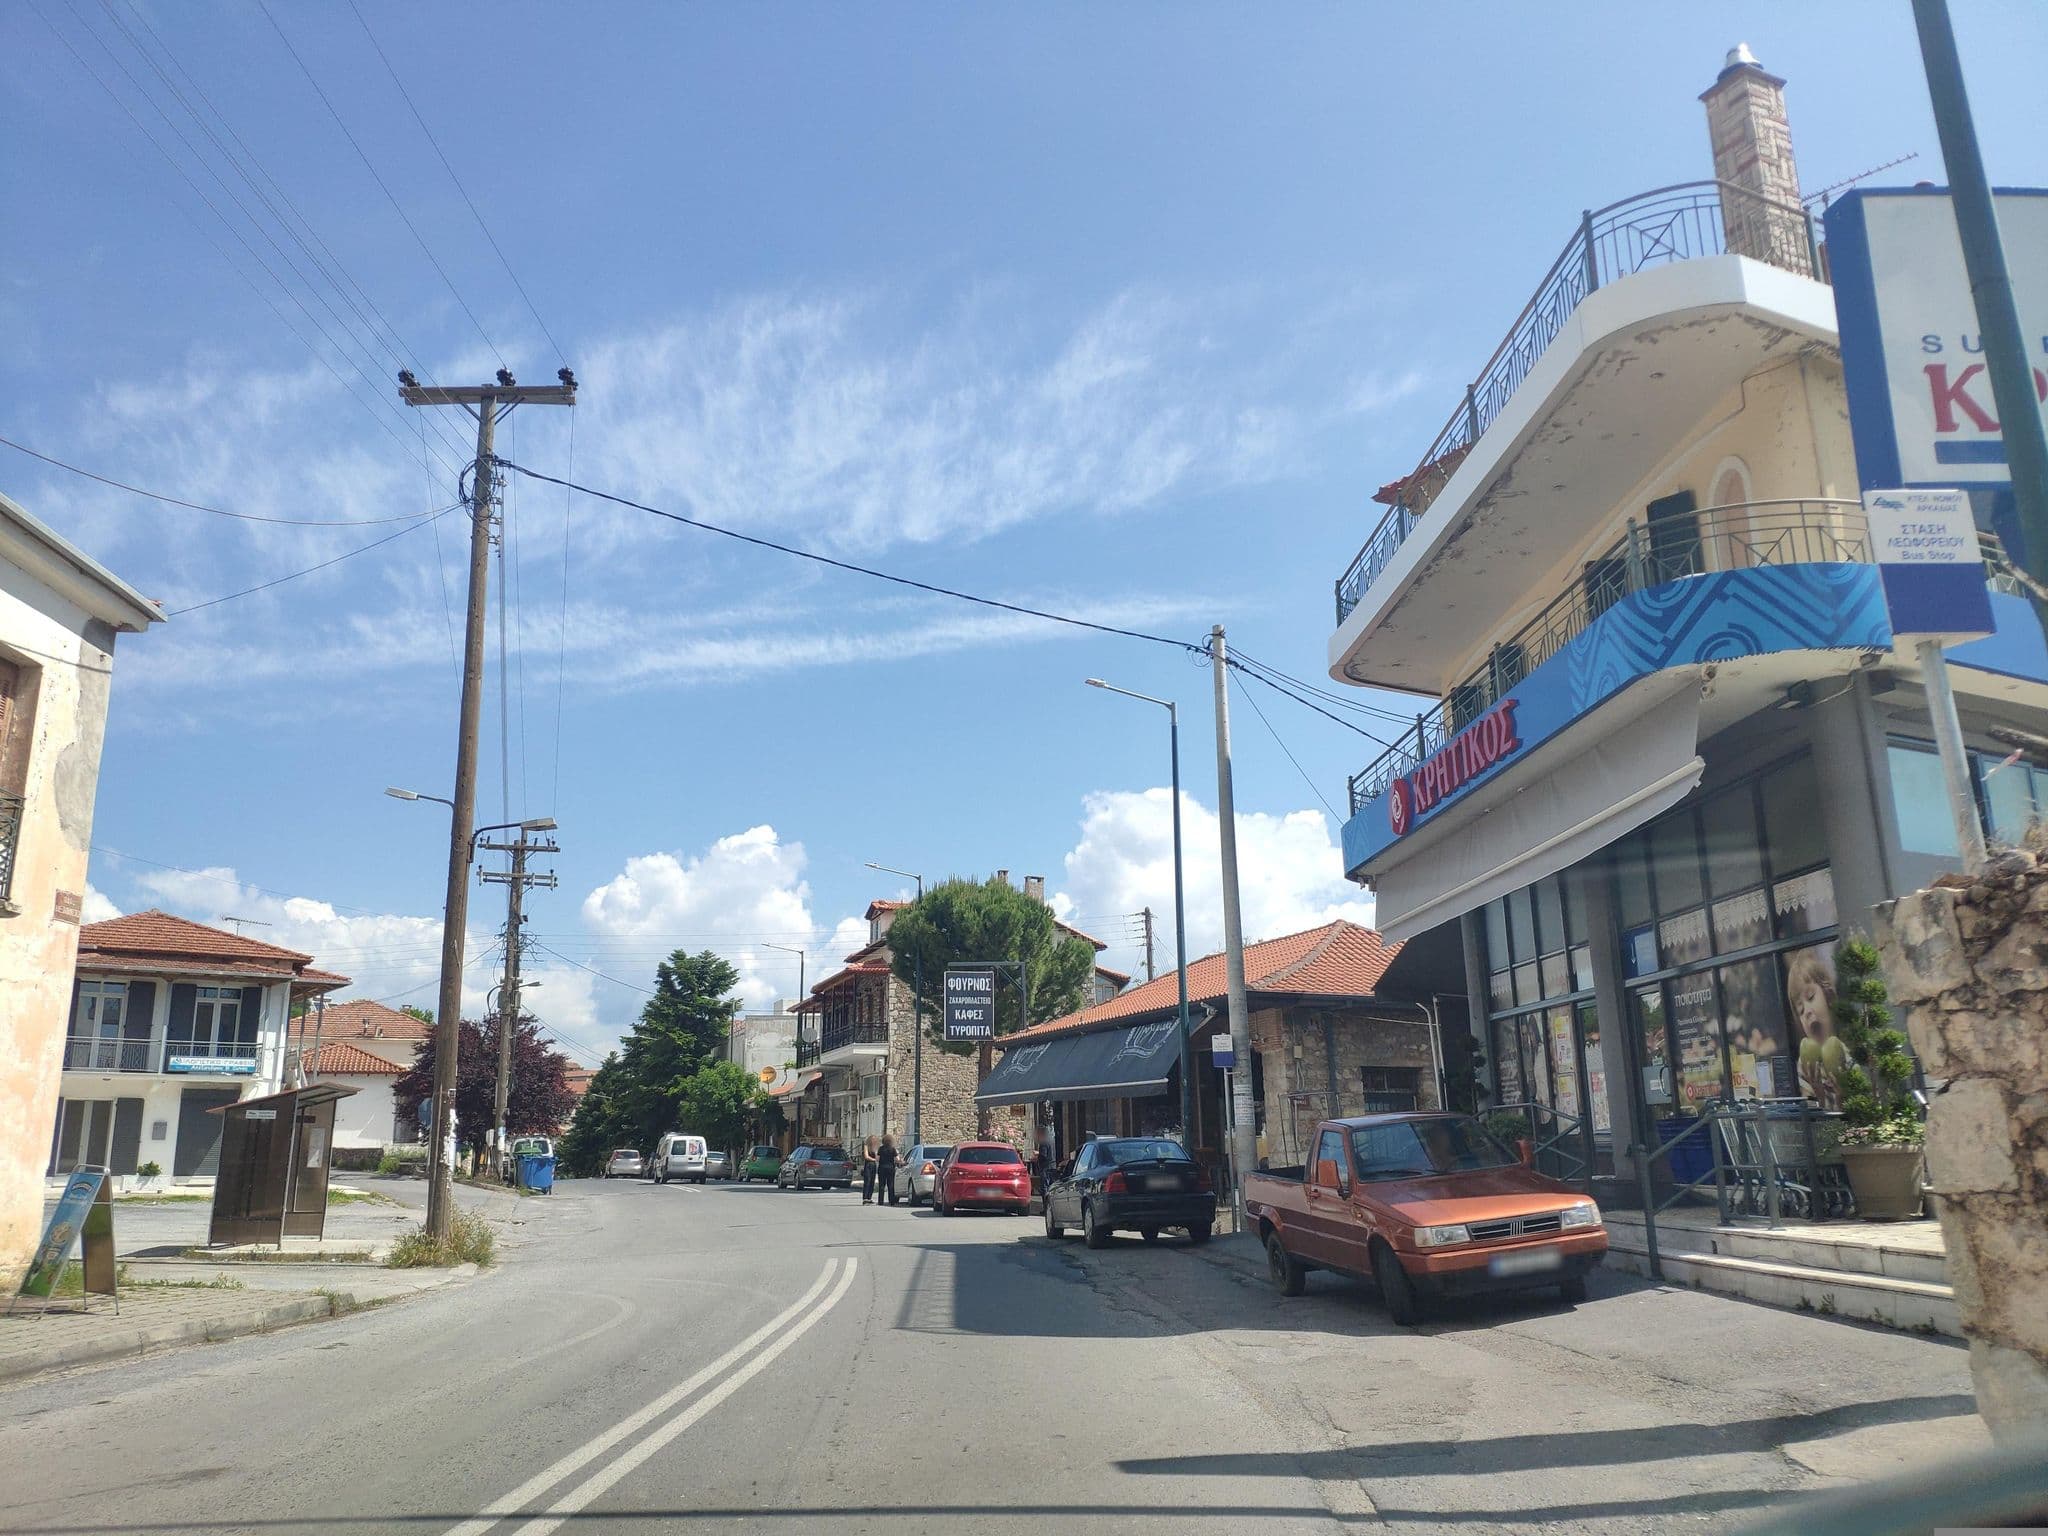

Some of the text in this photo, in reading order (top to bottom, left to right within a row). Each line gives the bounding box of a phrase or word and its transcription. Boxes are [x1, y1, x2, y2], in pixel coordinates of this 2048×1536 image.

[1901, 524, 1947, 535] ΣΤΑΣΗ
[1888, 537, 1965, 548] ΛΕΩΦΟΡΕΙΟΥ
[1901, 551, 1956, 561] Bus Stop
[1411, 699, 1520, 815] ΚΡΗΤΙΚΟΣ
[947, 977, 992, 992] ΦΟΥΡΝΟΣ
[955, 1009, 984, 1020] ΚΑΦΕΣ
[949, 1025, 991, 1037] ΤΥΡΟΠΙΤΑ
